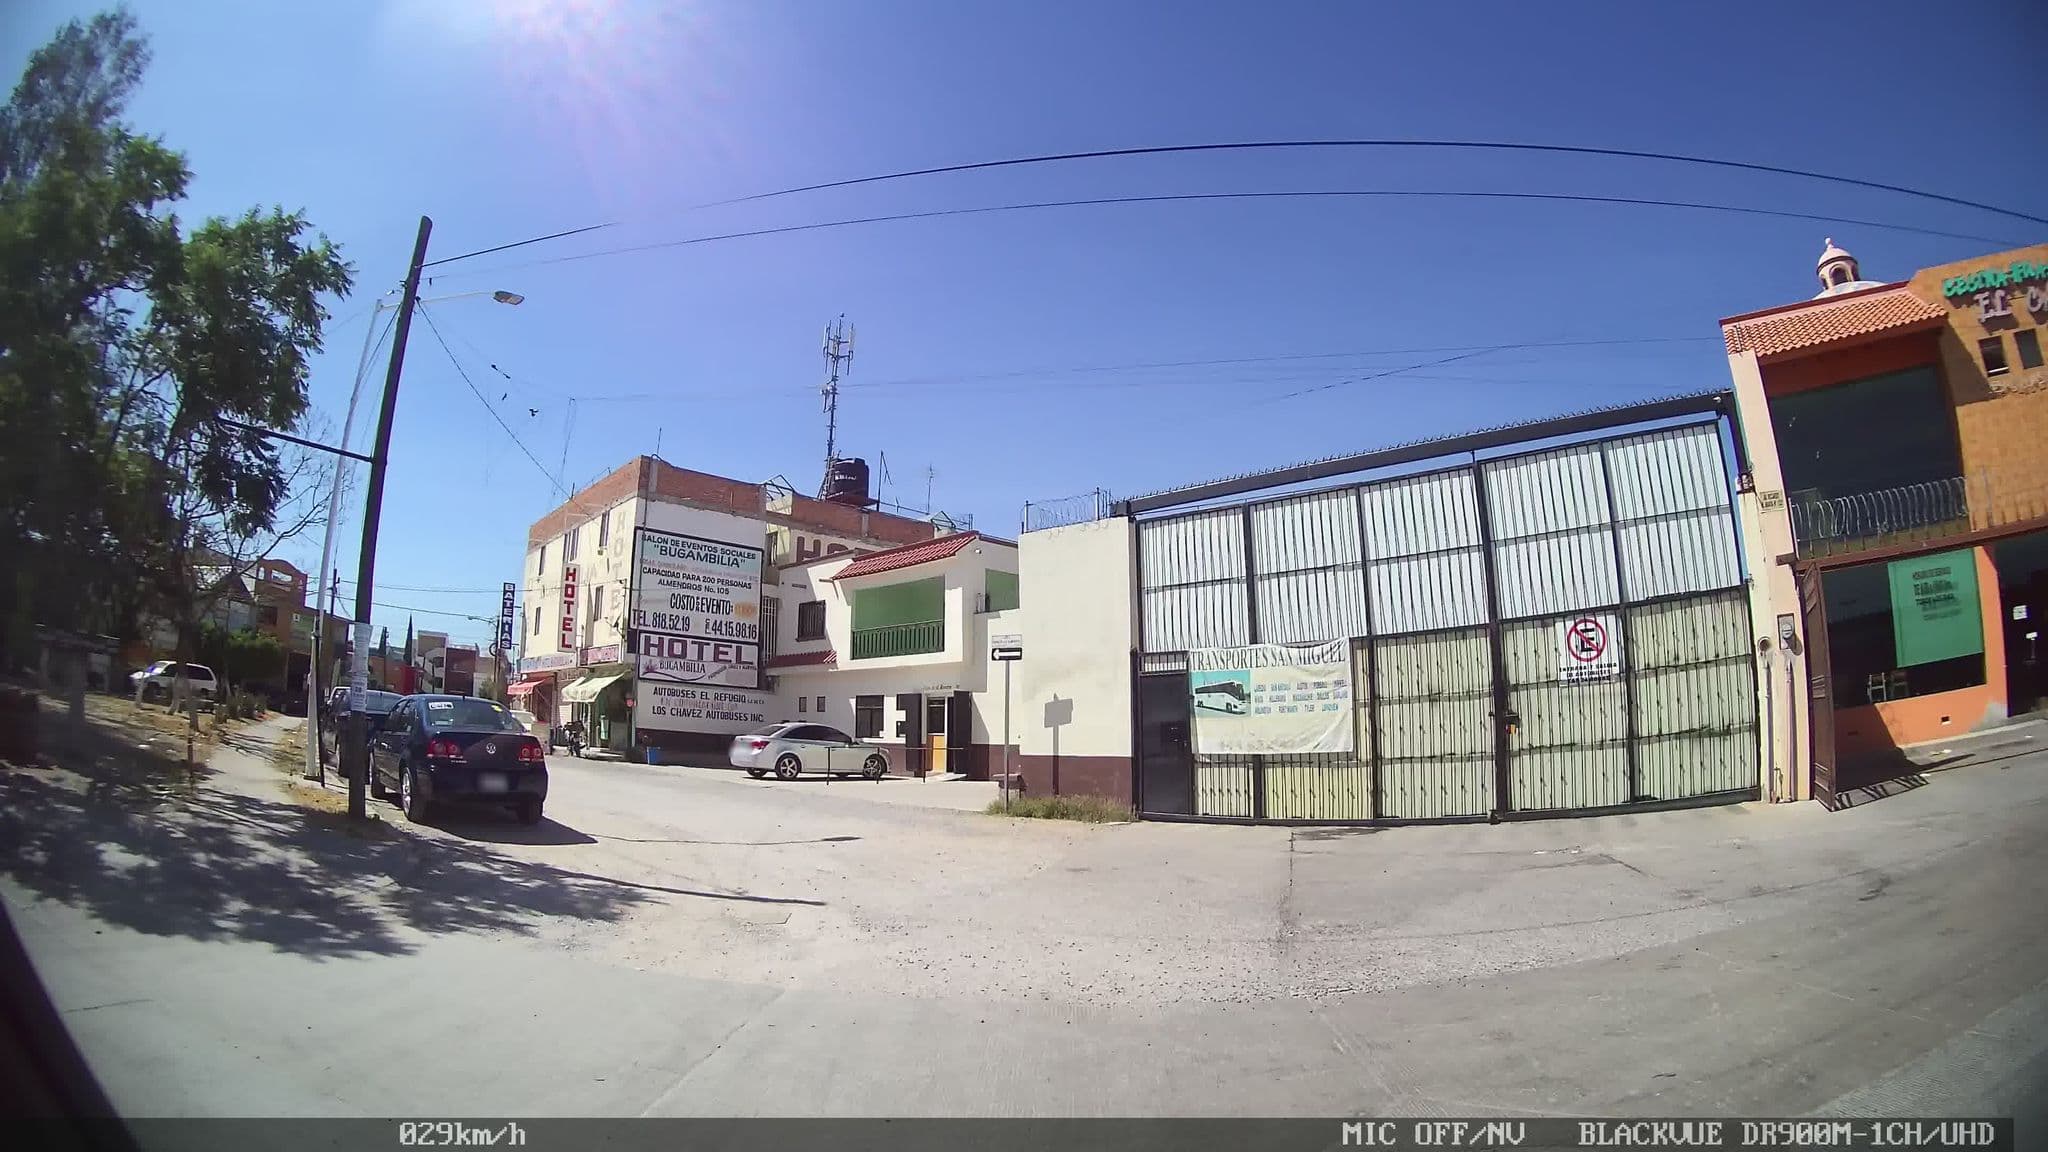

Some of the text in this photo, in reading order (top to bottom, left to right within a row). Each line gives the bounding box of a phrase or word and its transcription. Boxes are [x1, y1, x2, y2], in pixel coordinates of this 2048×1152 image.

[670, 537, 680, 547] DE
[681, 539, 718, 553] EVENTOS
[720, 547, 756, 560] SOCIALES
[642, 566, 680, 579] CAPACIDAD
[682, 573, 700, 582] PARA
[702, 576, 716, 584] 200
[716, 578, 752, 590] PERSONAS
[658, 580, 702, 592] ALMENDROS
[717, 587, 730, 595] 105
[501, 584, 514, 648] BATERIAS
[562, 567, 577, 648] HOTEL
[670, 593, 695, 611] COSTO
[700, 597, 733, 615] EVENTO:
[632, 608, 650, 627] TEL.
[652, 612, 690, 632] 818.52.19
[644, 635, 754, 664] HOTEL
[1190, 642, 1346, 670] TRANSPORTES SAN MIGUEL
[653, 686, 696, 699] AUTOBUSES
[700, 691, 710, 700] EL
[714, 692, 746, 704] REFUGIO
[652, 706, 666, 715] LOS
[670, 708, 702, 718] CHAVEZ
[706, 710, 748, 722] AUTOBUSES
